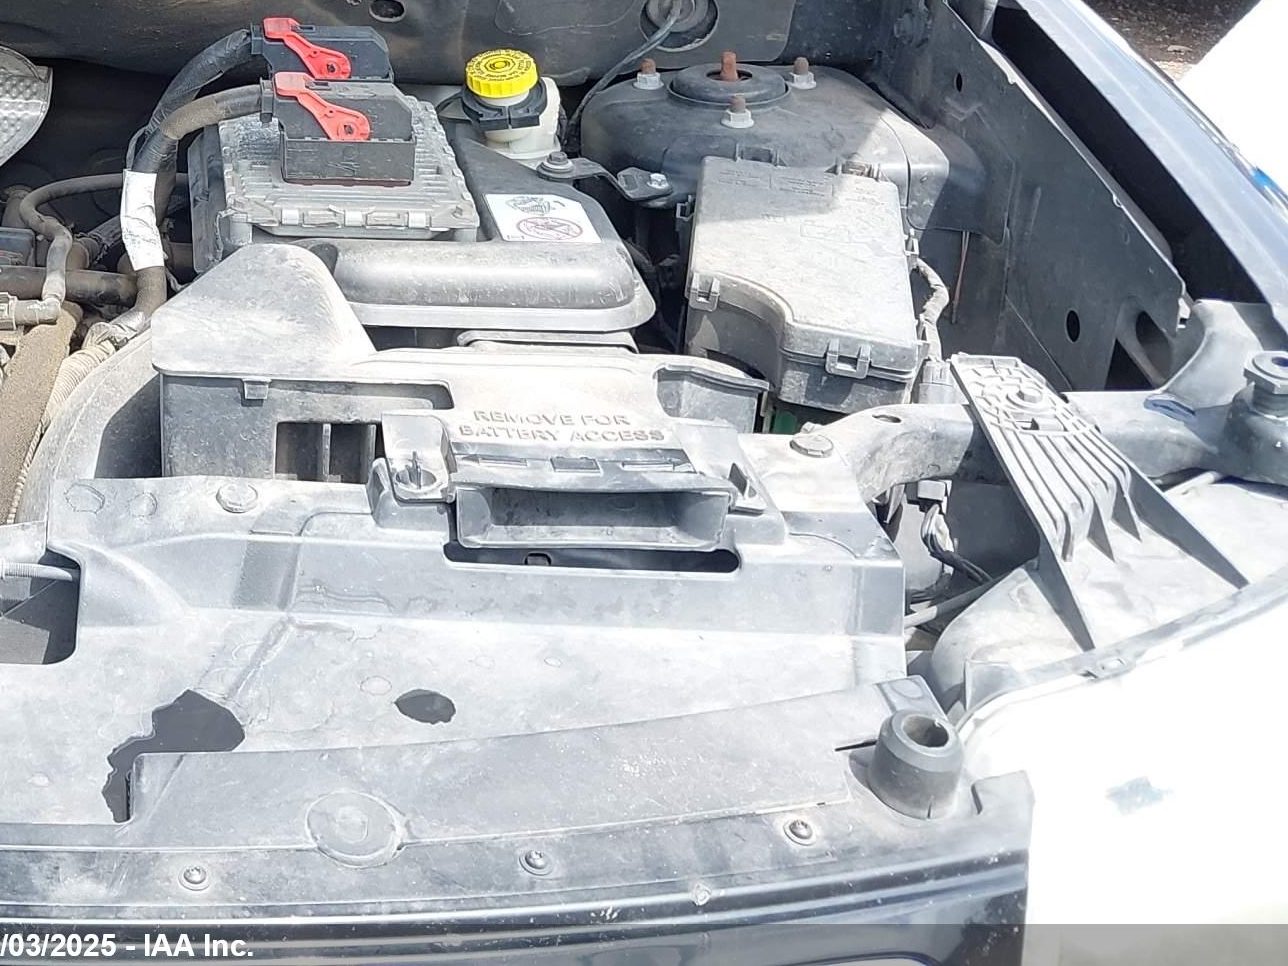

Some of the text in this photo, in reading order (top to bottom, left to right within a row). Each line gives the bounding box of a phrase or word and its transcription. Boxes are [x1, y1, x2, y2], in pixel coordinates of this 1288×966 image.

[474, 411, 631, 426] REMOVE FOR
[458, 425, 665, 442] BATTERY ACCESS
